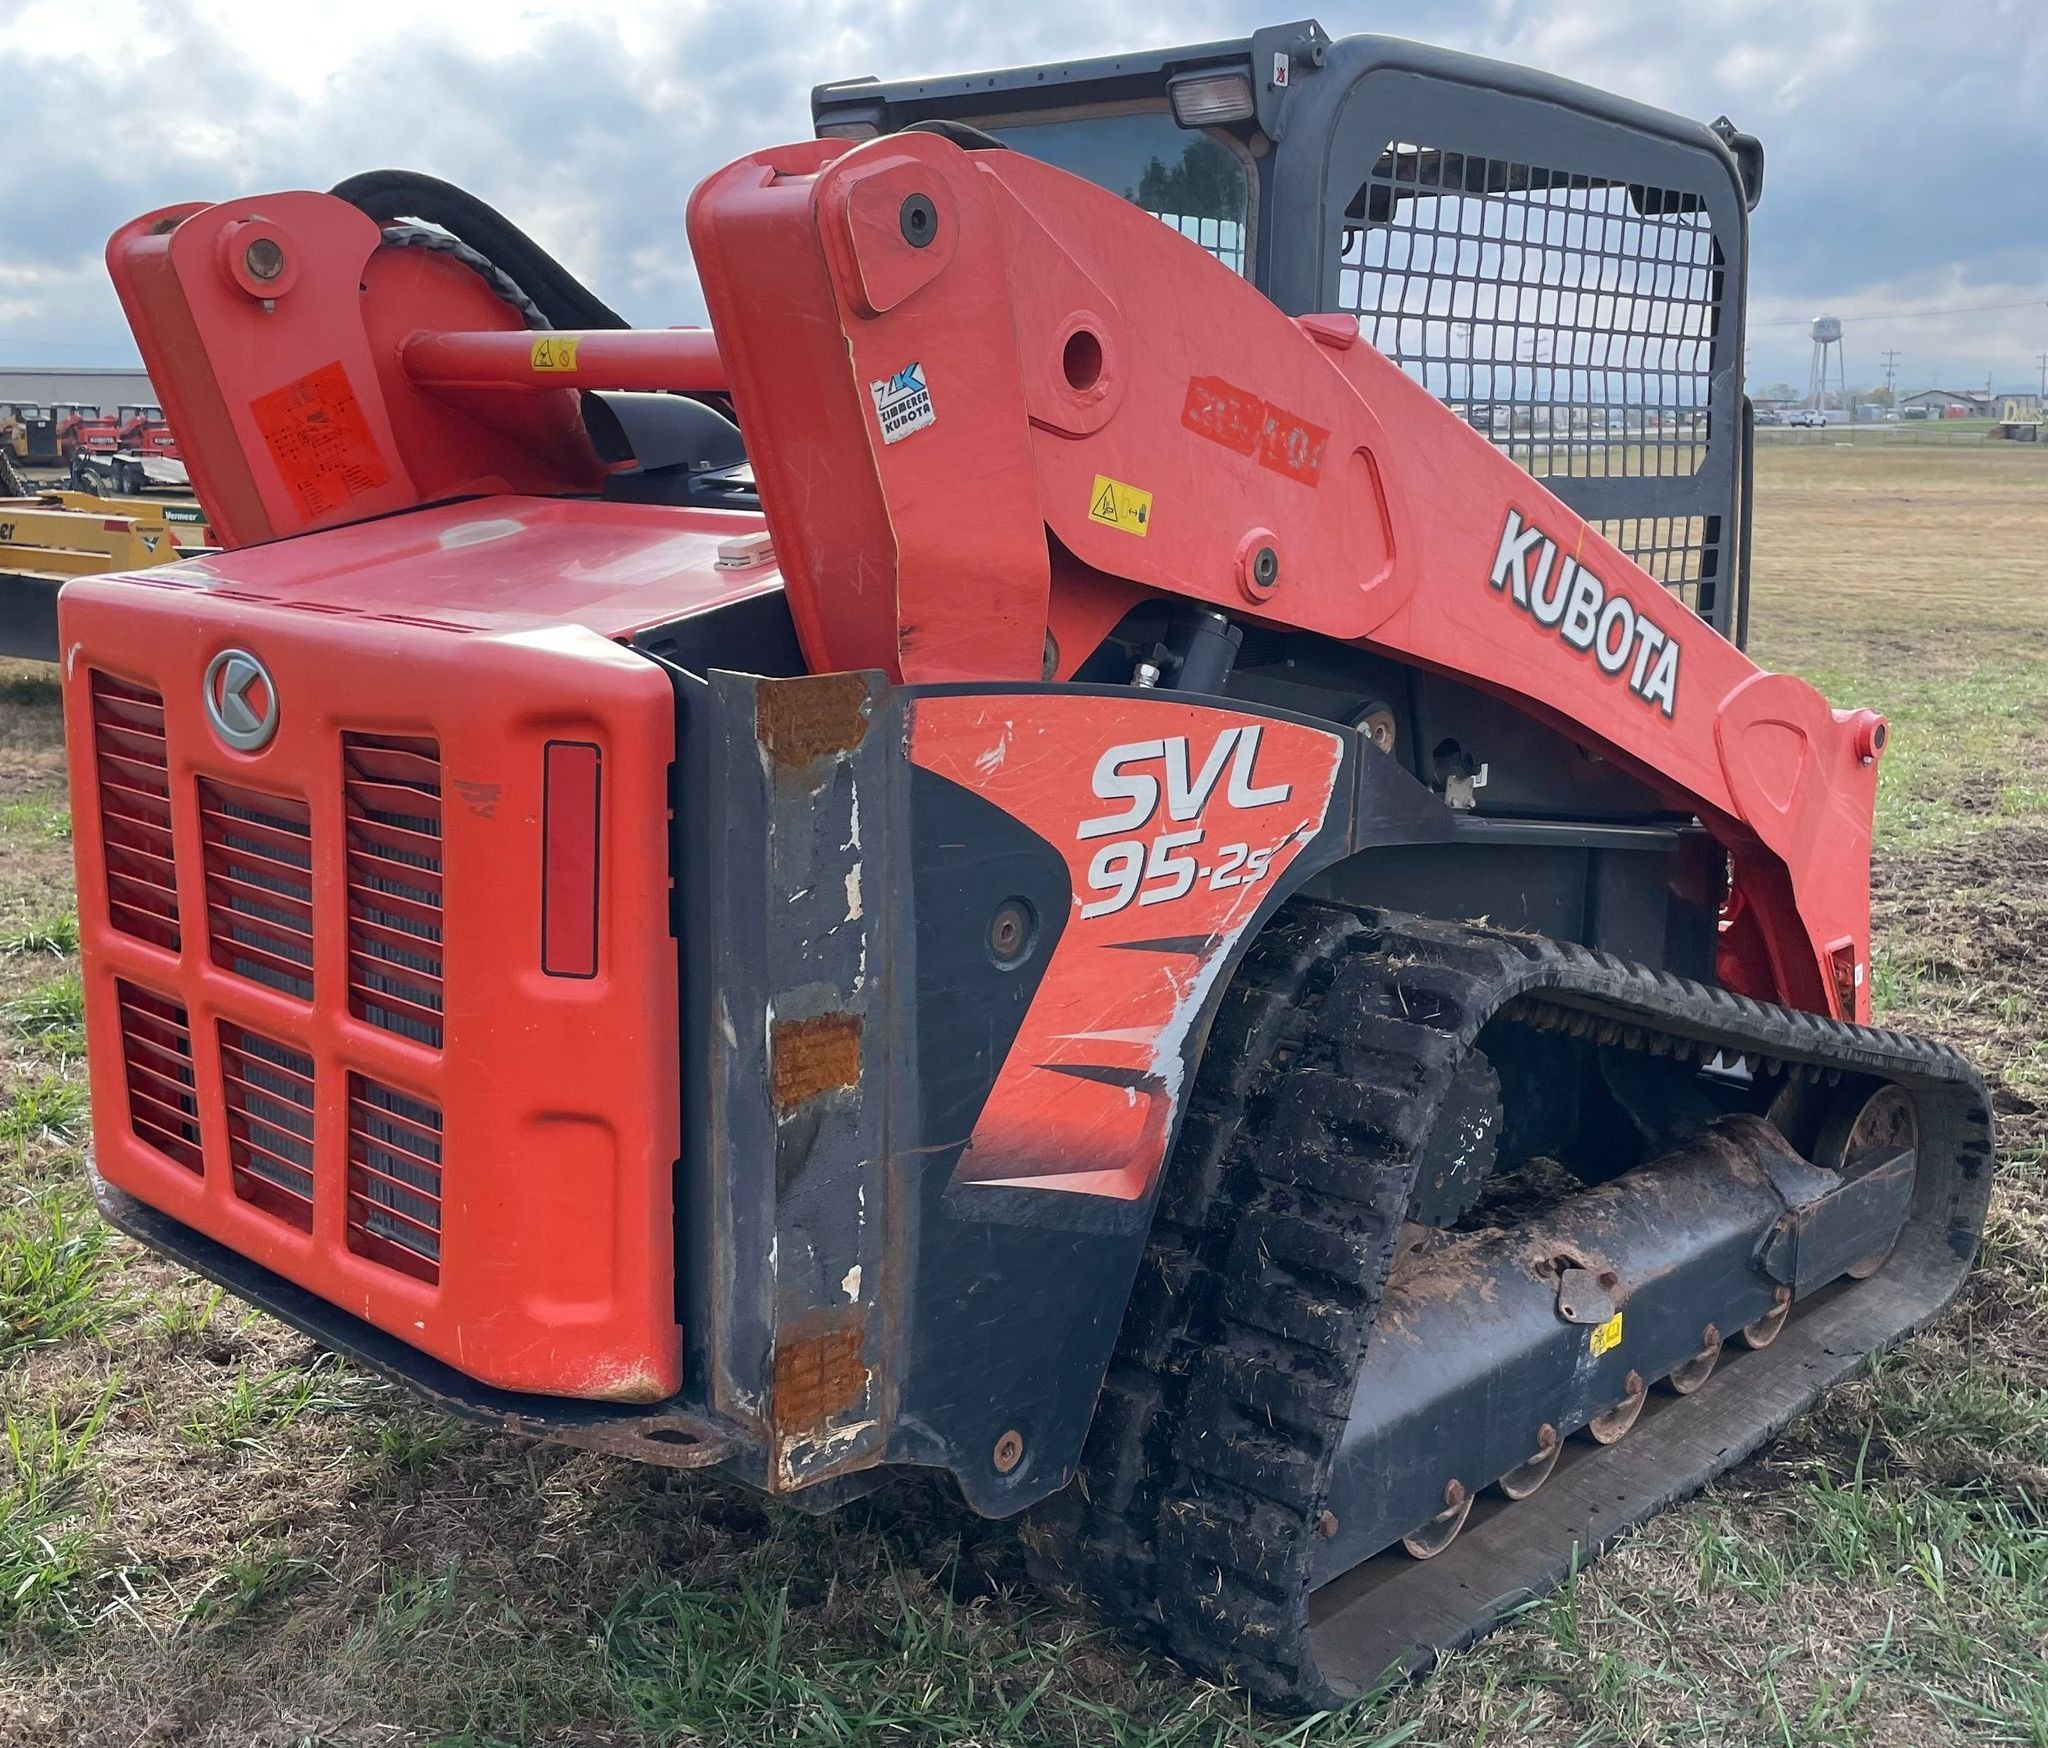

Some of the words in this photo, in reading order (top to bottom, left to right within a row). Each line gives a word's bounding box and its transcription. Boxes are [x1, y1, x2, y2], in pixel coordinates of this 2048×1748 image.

[881, 391, 929, 422] ZIMMERER
[885, 403, 931, 434] KUBOTA
[164, 511, 199, 521] Vermeer
[1489, 508, 1680, 718] KUBOTA
[1076, 725, 1293, 840] SVL
